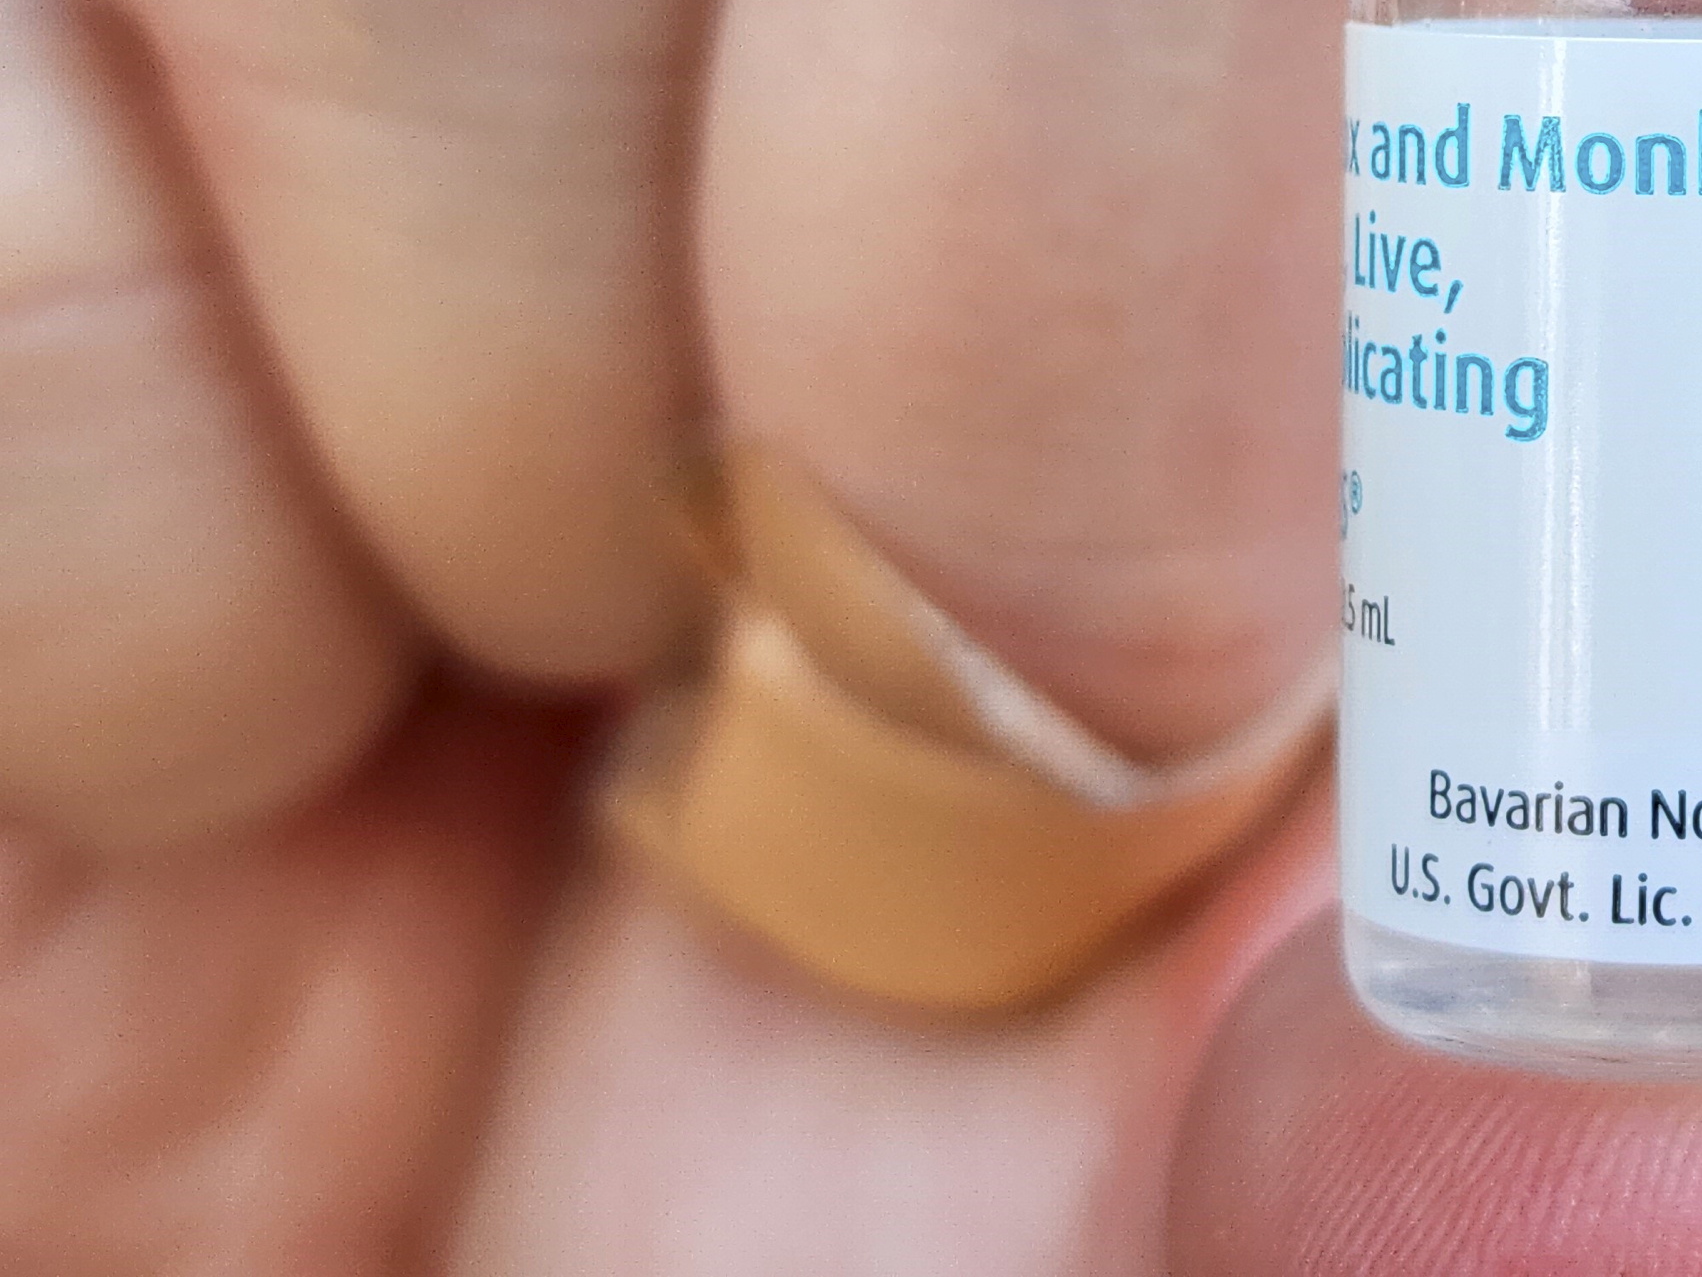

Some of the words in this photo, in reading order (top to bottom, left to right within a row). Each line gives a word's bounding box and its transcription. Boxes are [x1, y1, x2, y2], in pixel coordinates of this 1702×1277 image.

[1370, 101, 1471, 188] and
[1354, 209, 1464, 315] Live,
[1360, 594, 1396, 647] mL
[1429, 768, 1629, 838] Bavarian
[1391, 842, 1451, 905] U.S.
[1467, 862, 1590, 922] Govt.
[1611, 872, 1693, 927] Lic.
